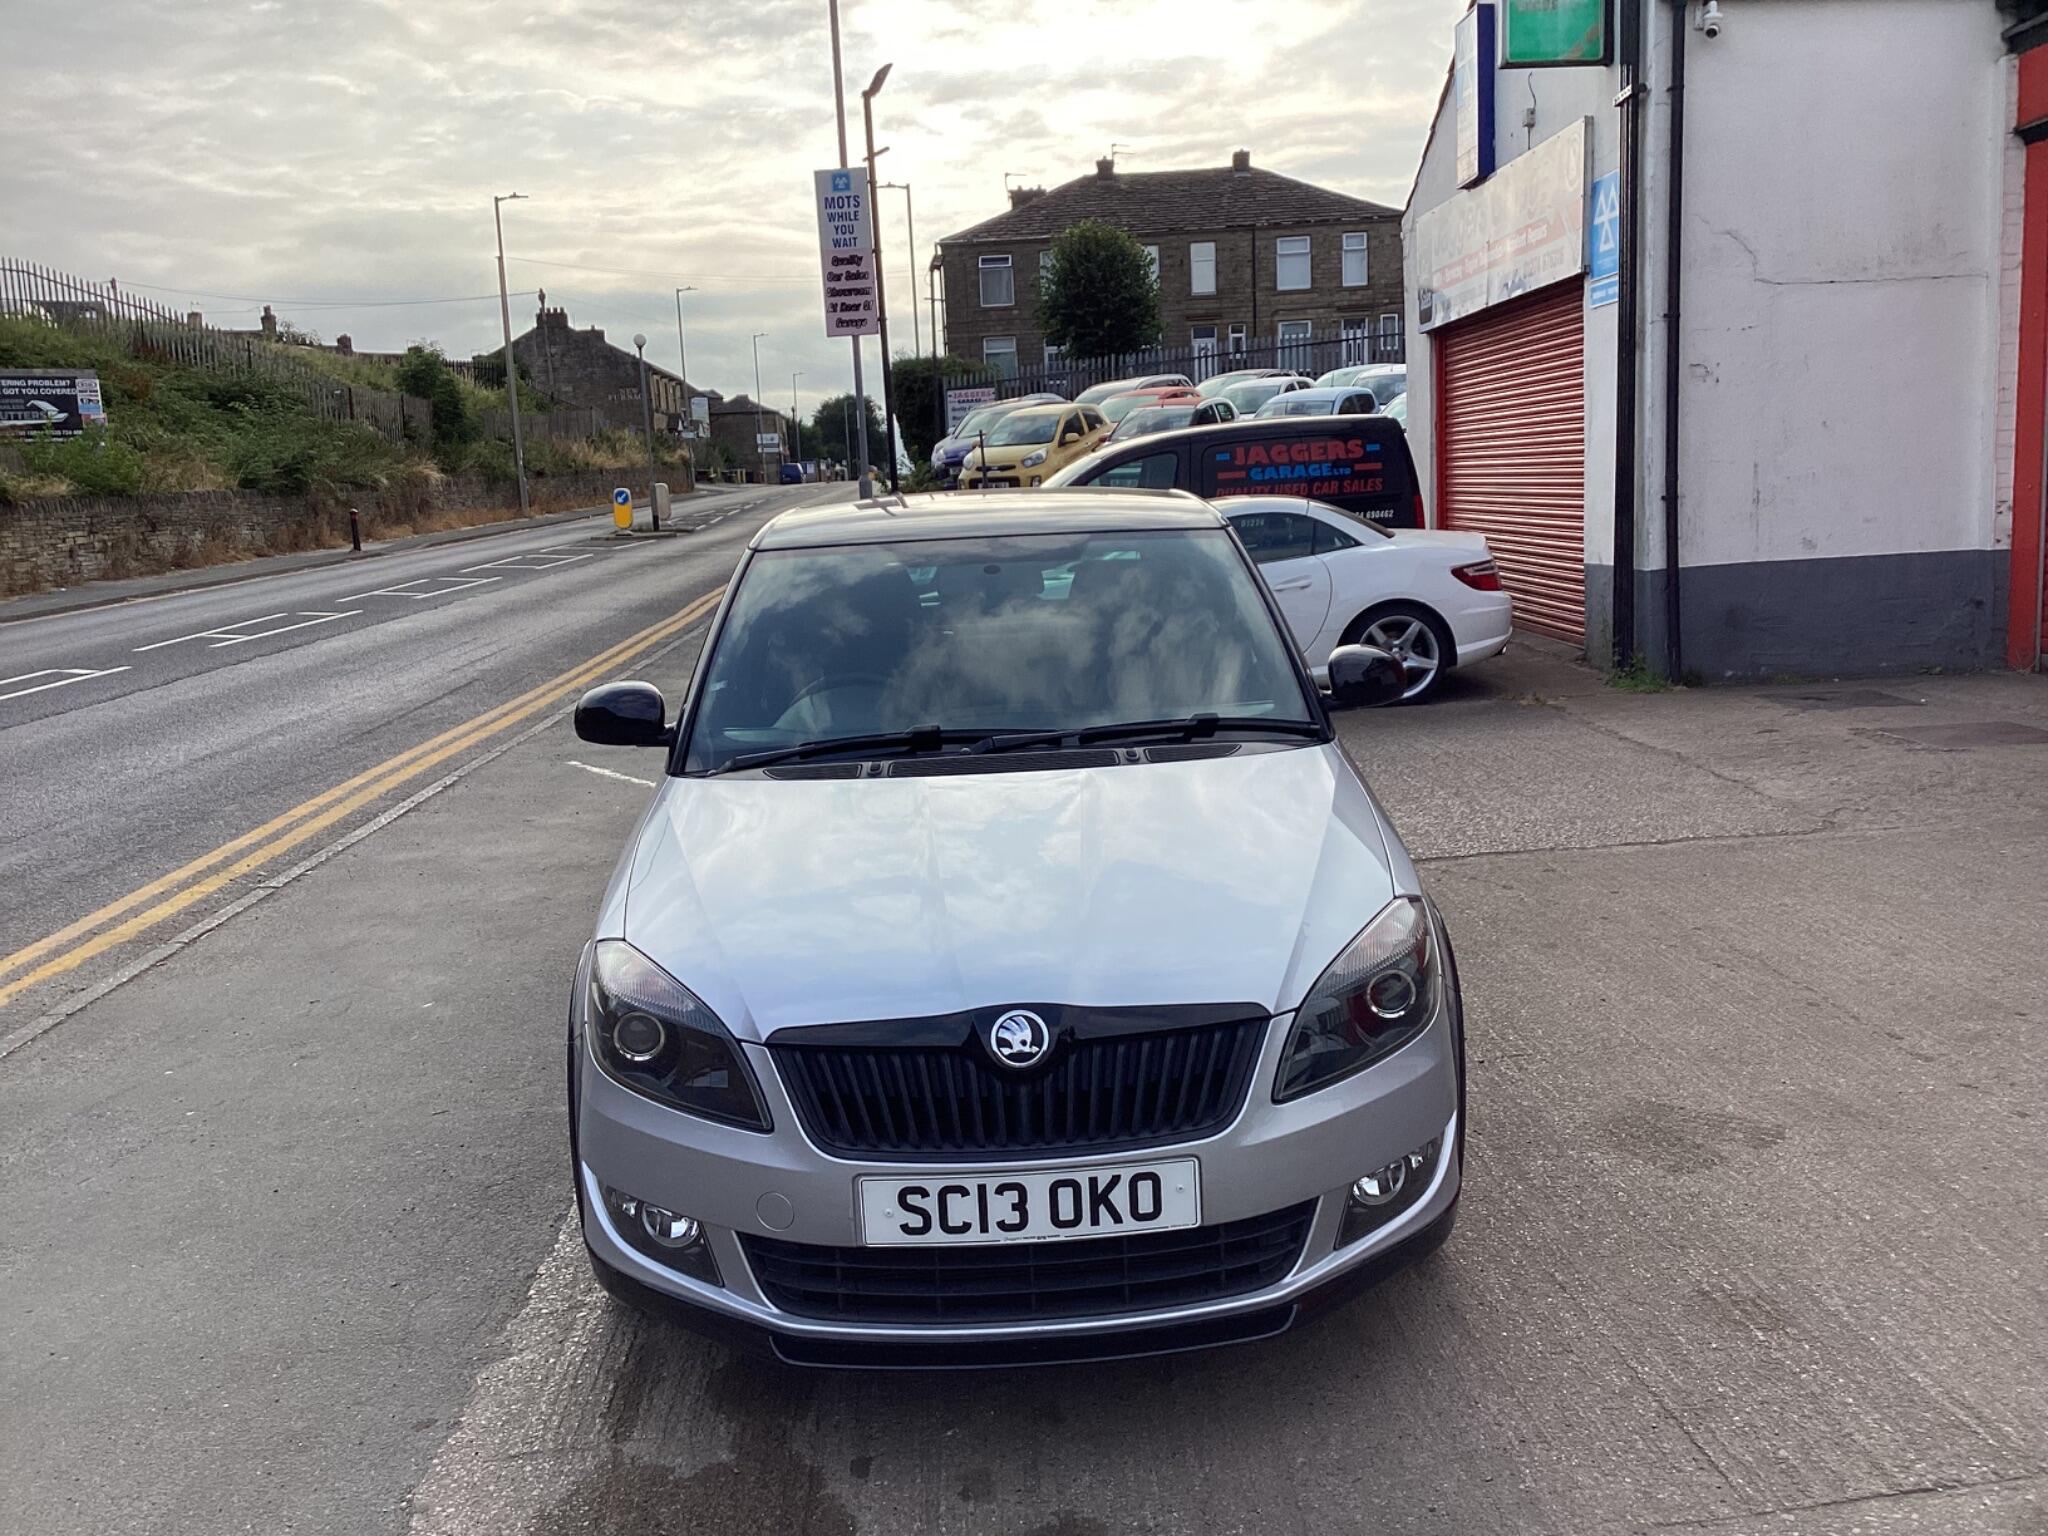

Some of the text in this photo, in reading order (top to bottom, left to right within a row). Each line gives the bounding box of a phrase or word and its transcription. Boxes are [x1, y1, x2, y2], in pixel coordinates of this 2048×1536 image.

[824, 194, 860, 210] MOTS
[827, 210, 859, 222] WHILE
[834, 224, 855, 235] YOU
[832, 237, 858, 248] WAIT
[1234, 439, 1365, 466] JAGGERS
[1250, 464, 1333, 481] GARAGE
[1275, 482, 1308, 496] USED
[1313, 480, 1339, 495] CAR
[1343, 477, 1384, 492] SALES
[897, 1171, 1163, 1236] SC13 OKO
